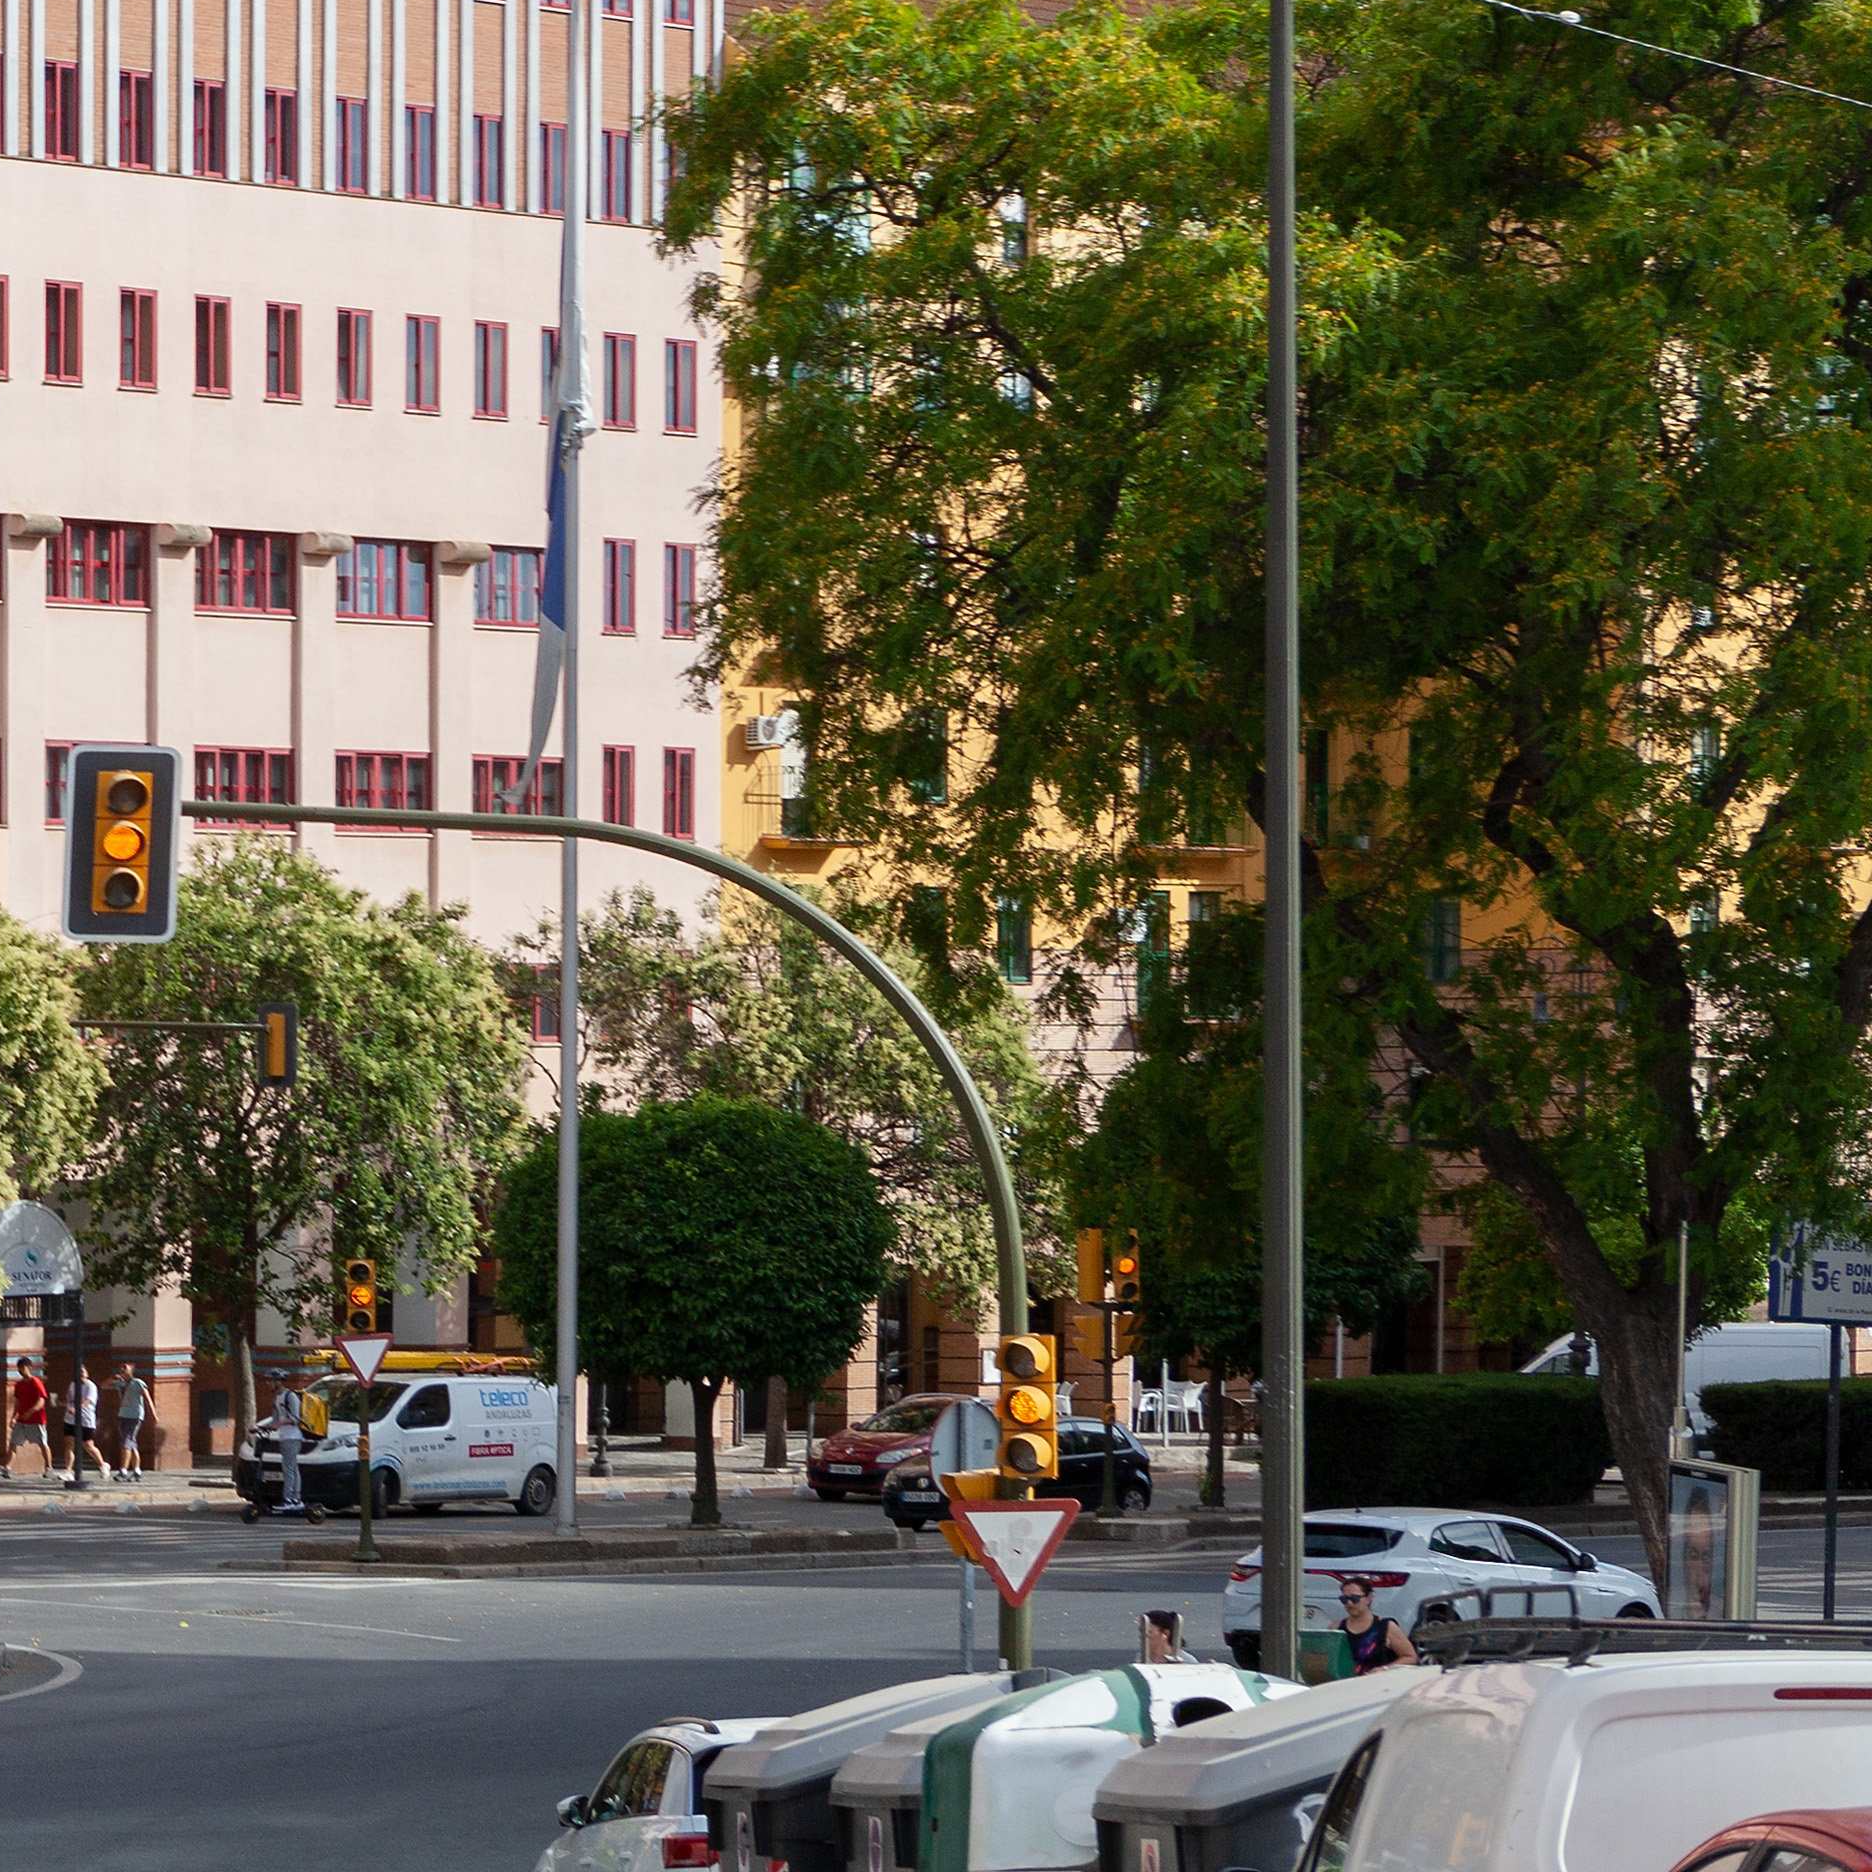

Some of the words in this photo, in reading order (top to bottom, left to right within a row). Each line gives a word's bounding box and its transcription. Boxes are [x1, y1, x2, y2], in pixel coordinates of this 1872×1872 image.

[12, 1271, 53, 1281] SENATOR
[1812, 1261, 1841, 1292] 5€
[479, 1388, 529, 1407] teleco
[486, 1409, 532, 1420] ANDALUZAS
